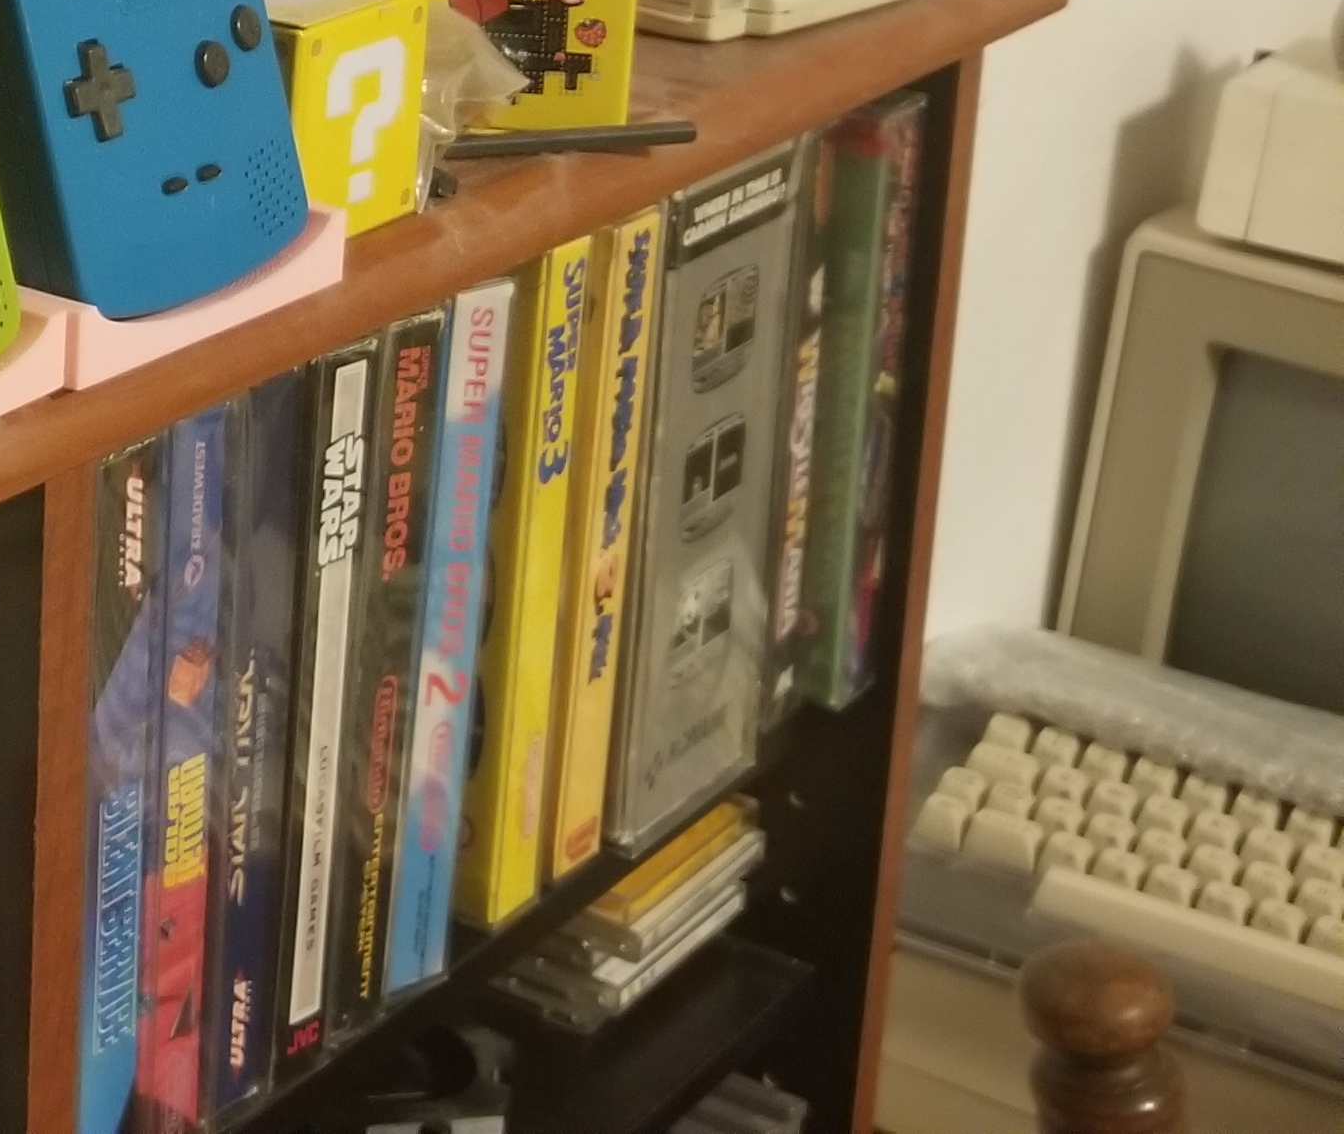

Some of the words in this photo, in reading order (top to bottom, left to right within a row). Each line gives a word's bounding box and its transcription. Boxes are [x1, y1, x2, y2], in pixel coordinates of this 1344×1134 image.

[390, 346, 425, 467] MARIO
[462, 305, 494, 423] SUPER
[546, 324, 567, 445] MARIO
[317, 439, 347, 567] WARS
[339, 431, 365, 554] STAR
[449, 434, 485, 553] MARIO
[538, 440, 570, 486] 3
[123, 476, 144, 588] ULTRA
[382, 472, 412, 583] BROS.
[424, 670, 469, 708] 2
